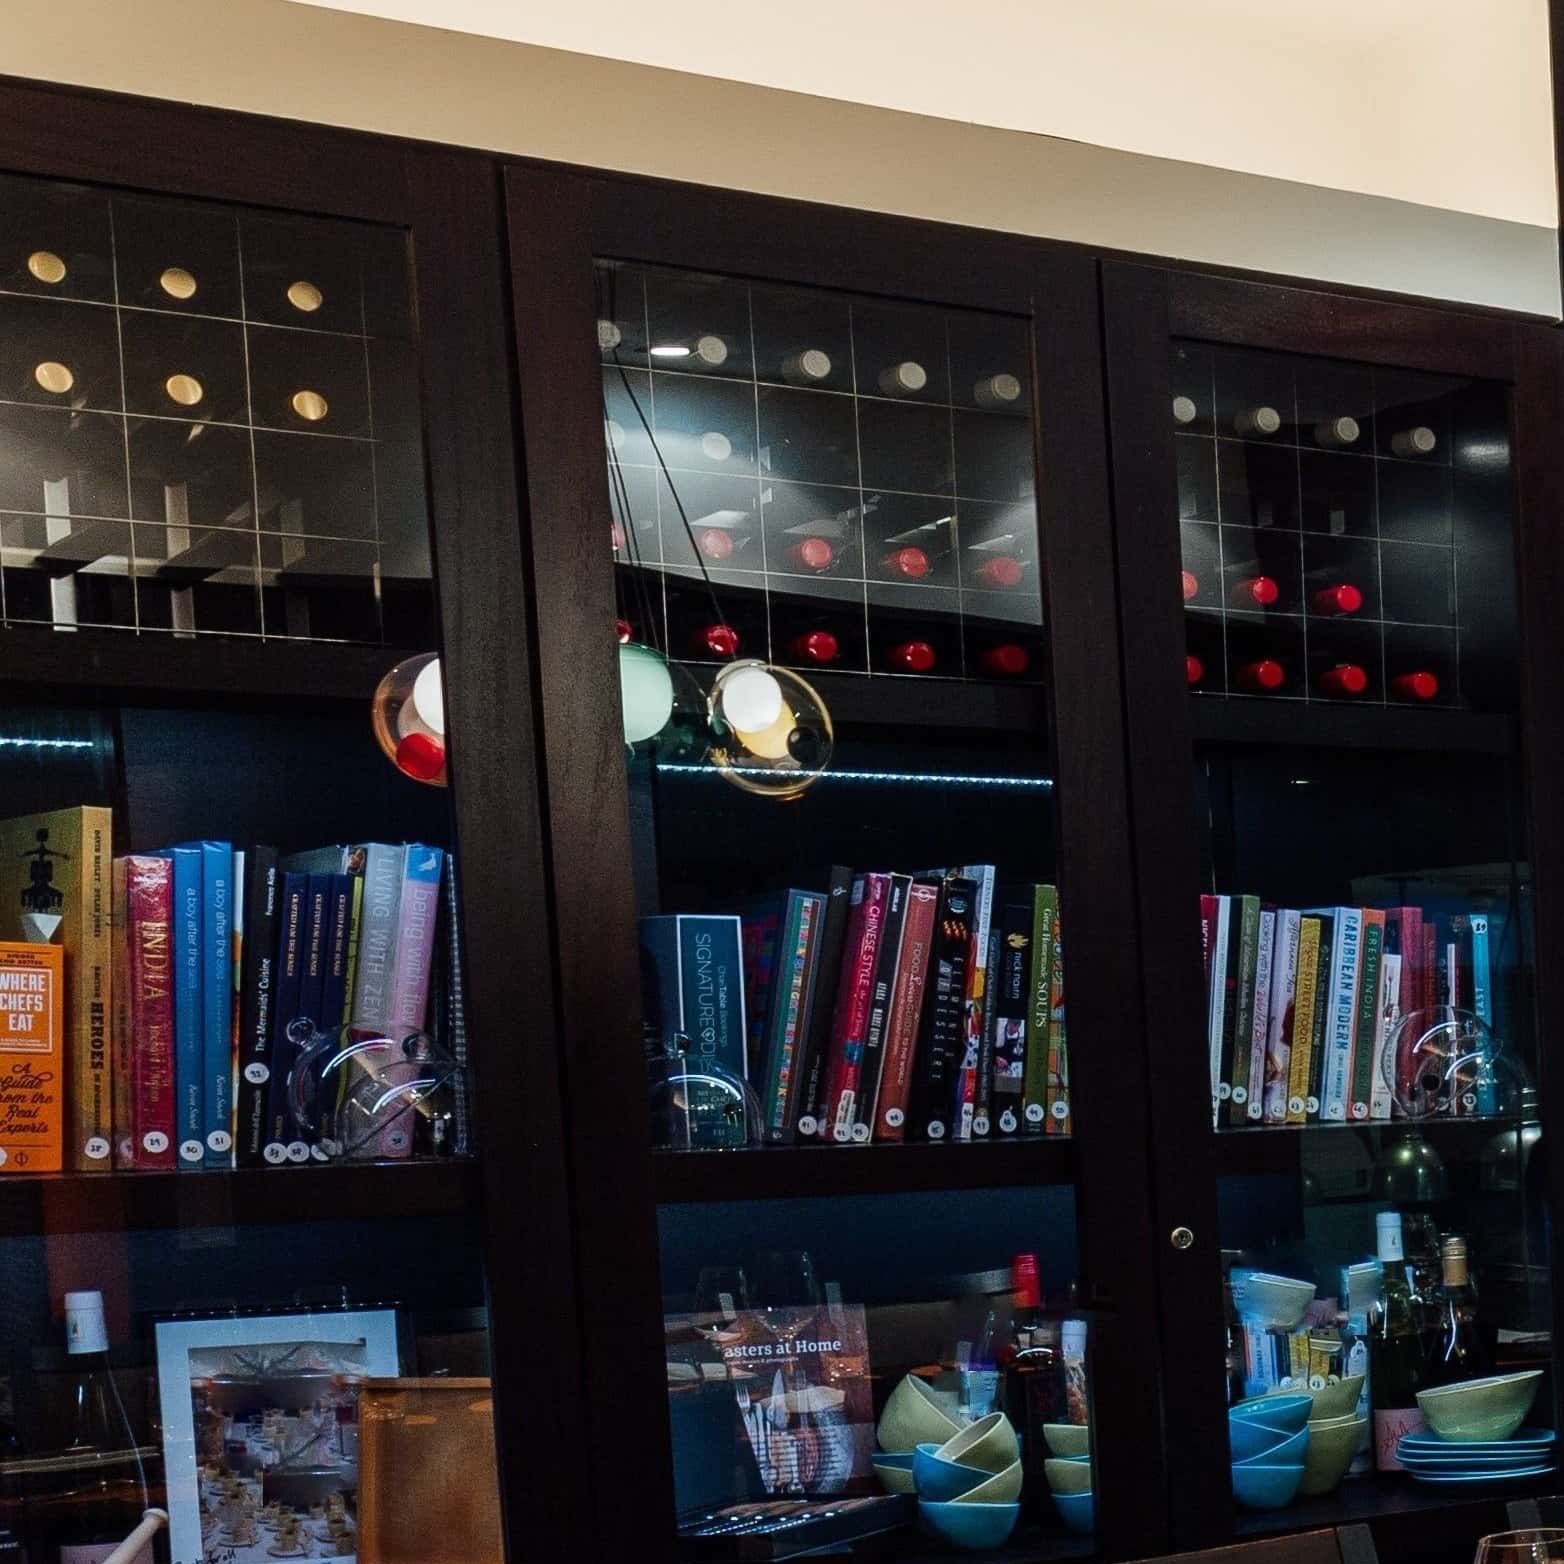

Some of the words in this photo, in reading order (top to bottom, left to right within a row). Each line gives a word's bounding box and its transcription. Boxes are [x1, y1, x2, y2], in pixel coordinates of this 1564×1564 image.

[372, 858, 396, 918] LIVING
[187, 920, 199, 946] after
[215, 911, 227, 937] after
[403, 889, 432, 941] being
[863, 905, 880, 952] CHINESE
[1041, 908, 1052, 932] Great
[216, 938, 227, 958] the
[367, 929, 387, 974] WITH
[1259, 914, 1271, 953] Cooking
[1364, 930, 1378, 973] FRESH
[142, 921, 168, 1001] INDIA
[187, 947, 199, 967] the
[406, 947, 426, 985] with
[858, 954, 873, 986] STYLE
[911, 942, 923, 973] FOOD
[1012, 951, 1025, 972] nick
[1039, 933, 1051, 979] Homemade
[1259, 954, 1269, 970] with
[1342, 916, 1359, 990] CARIBBEAN
[0, 972, 46, 993] WHERE
[258, 958, 271, 989] Cuisine
[695, 933, 715, 1027] SIGNATURE
[1303, 970, 1313, 1009] STREET
[0, 993, 44, 1012] CHEFS
[363, 984, 382, 1020] ZEN
[1034, 981, 1047, 1028] SOUPS
[1363, 977, 1376, 1019] INDIA
[9, 1014, 35, 1032] EAT
[90, 1002, 104, 1070] HEROES
[1300, 1013, 1311, 1045] FOOD
[1335, 994, 1352, 1050] MODERN
[254, 1037, 266, 1052] The
[724, 1344, 773, 1358] asters
[775, 1342, 792, 1354] at
[795, 1339, 842, 1353] Home
